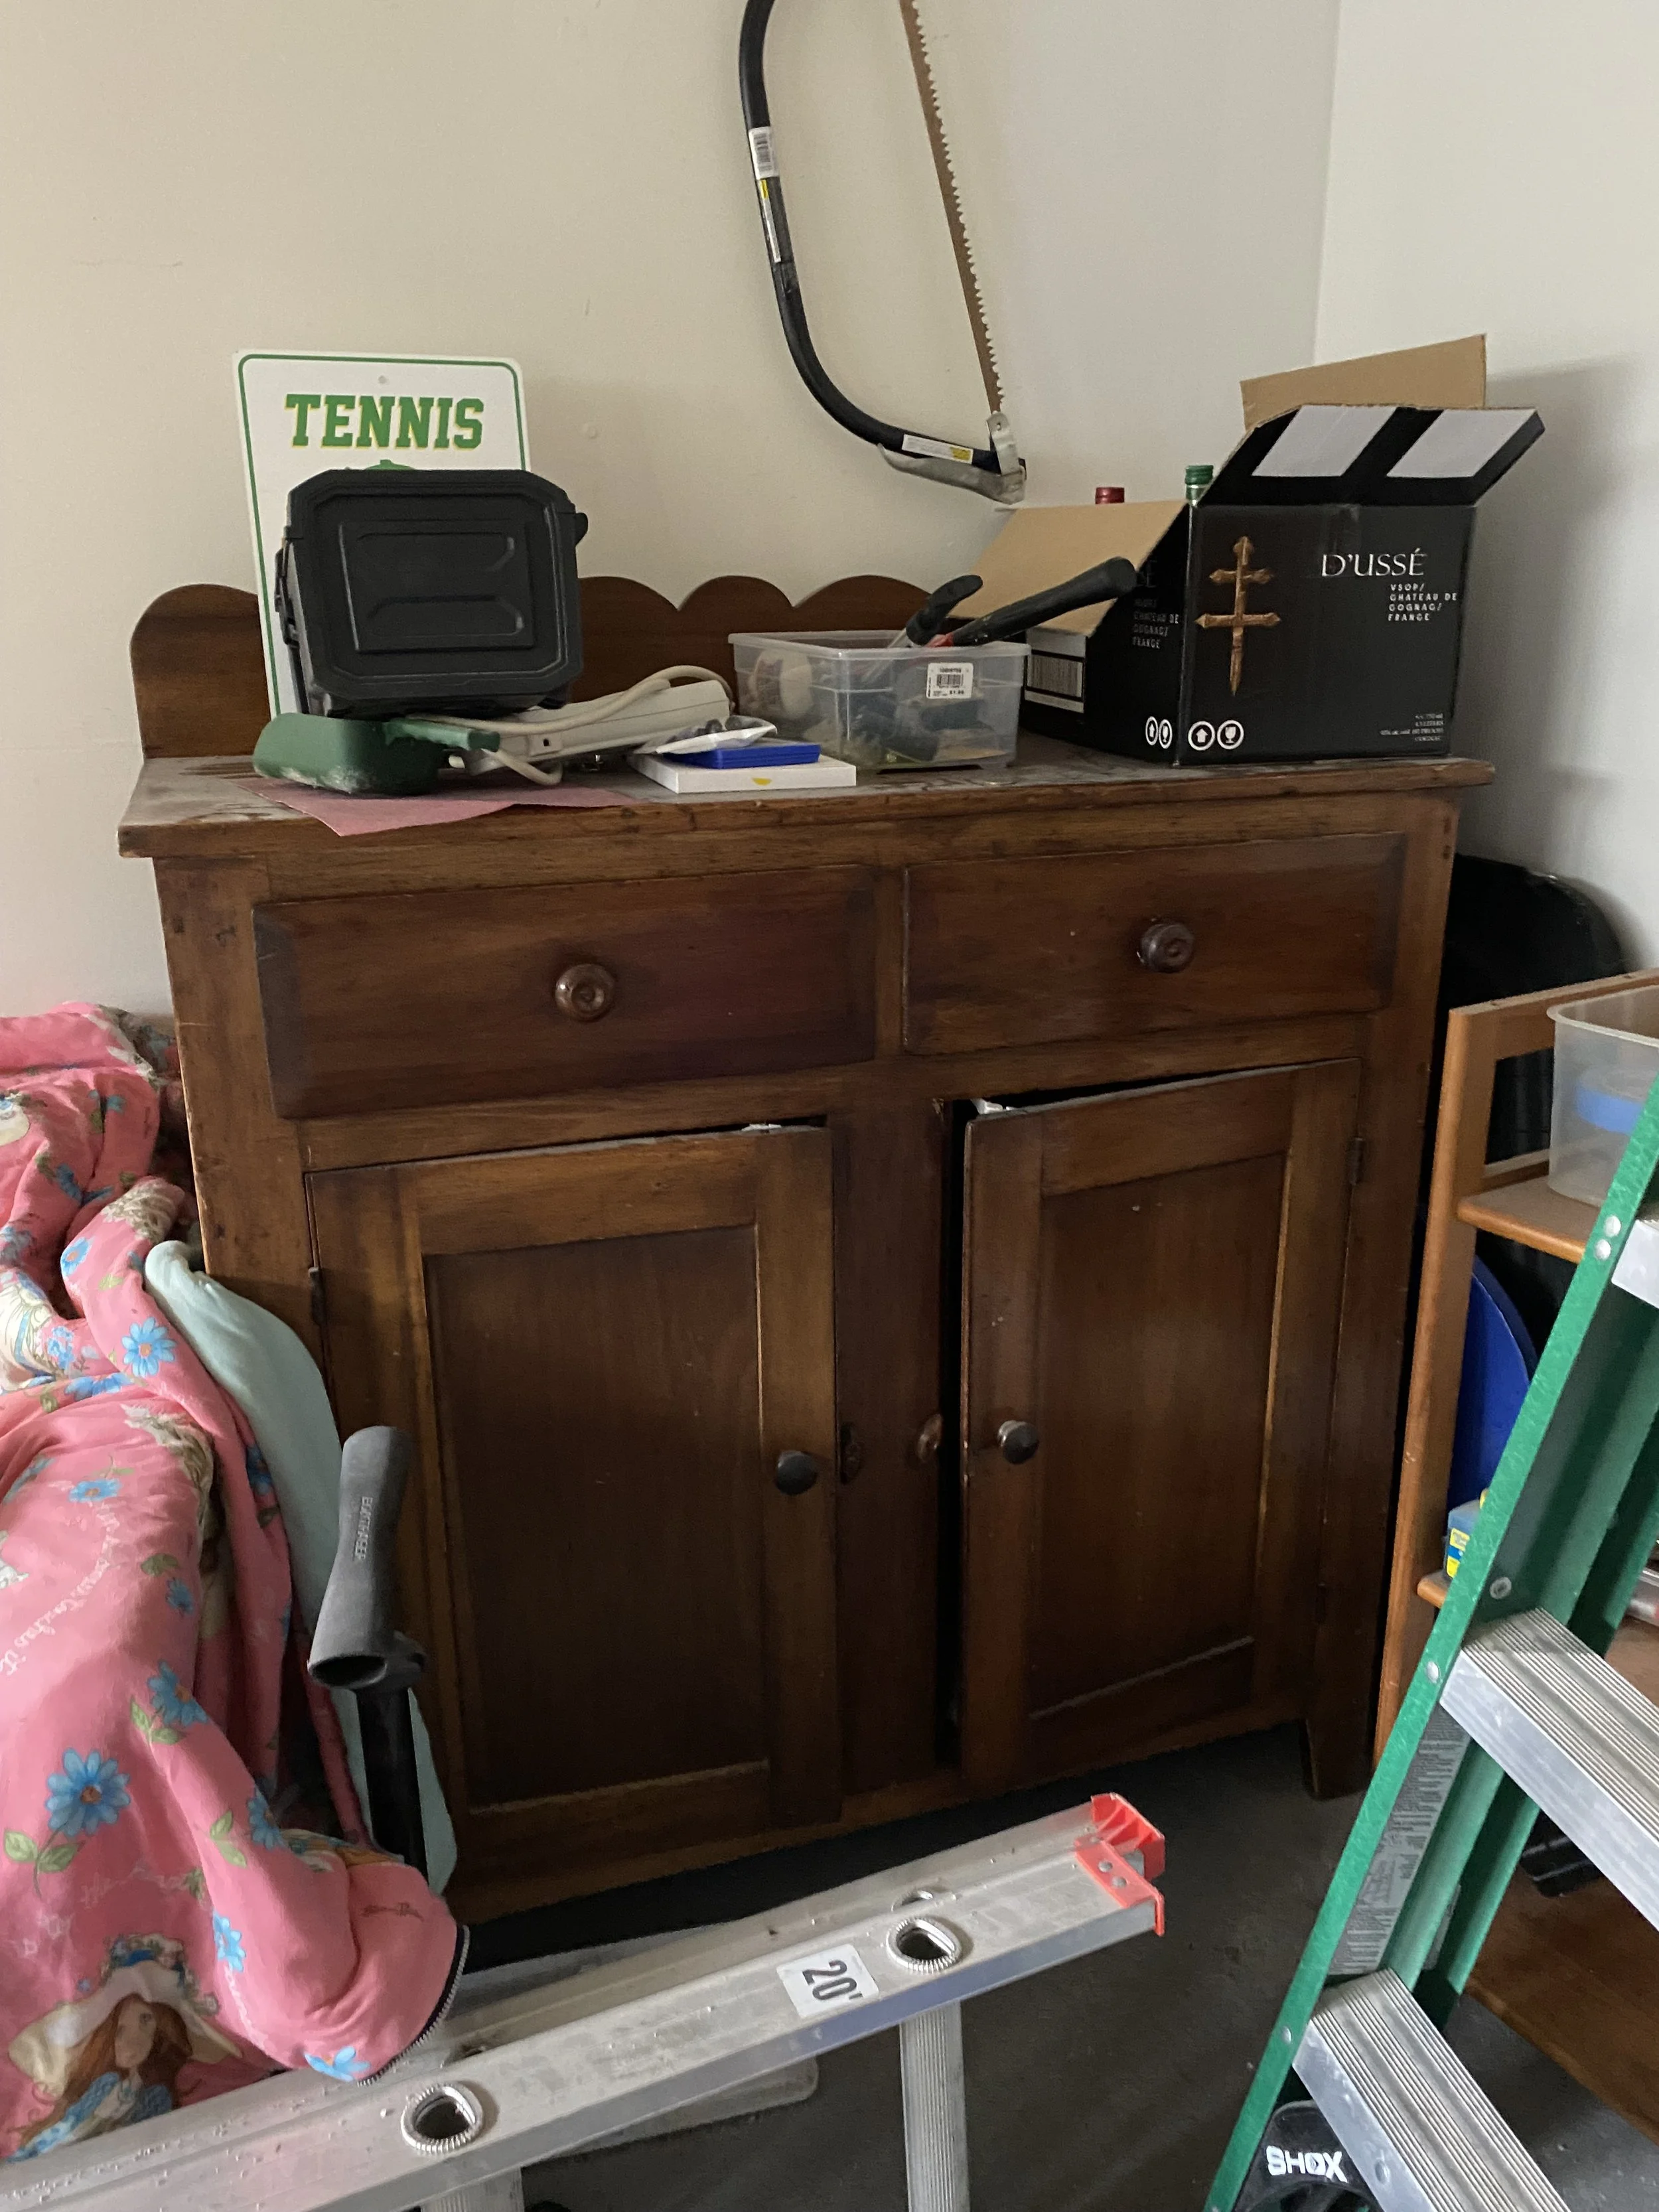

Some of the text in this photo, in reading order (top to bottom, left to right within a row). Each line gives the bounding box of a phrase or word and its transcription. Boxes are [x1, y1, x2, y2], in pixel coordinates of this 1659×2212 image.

[285, 394, 484, 449] TENNIS
[1388, 613, 1429, 621] FRANCE
[1266, 2146, 1348, 2183] SHOX
